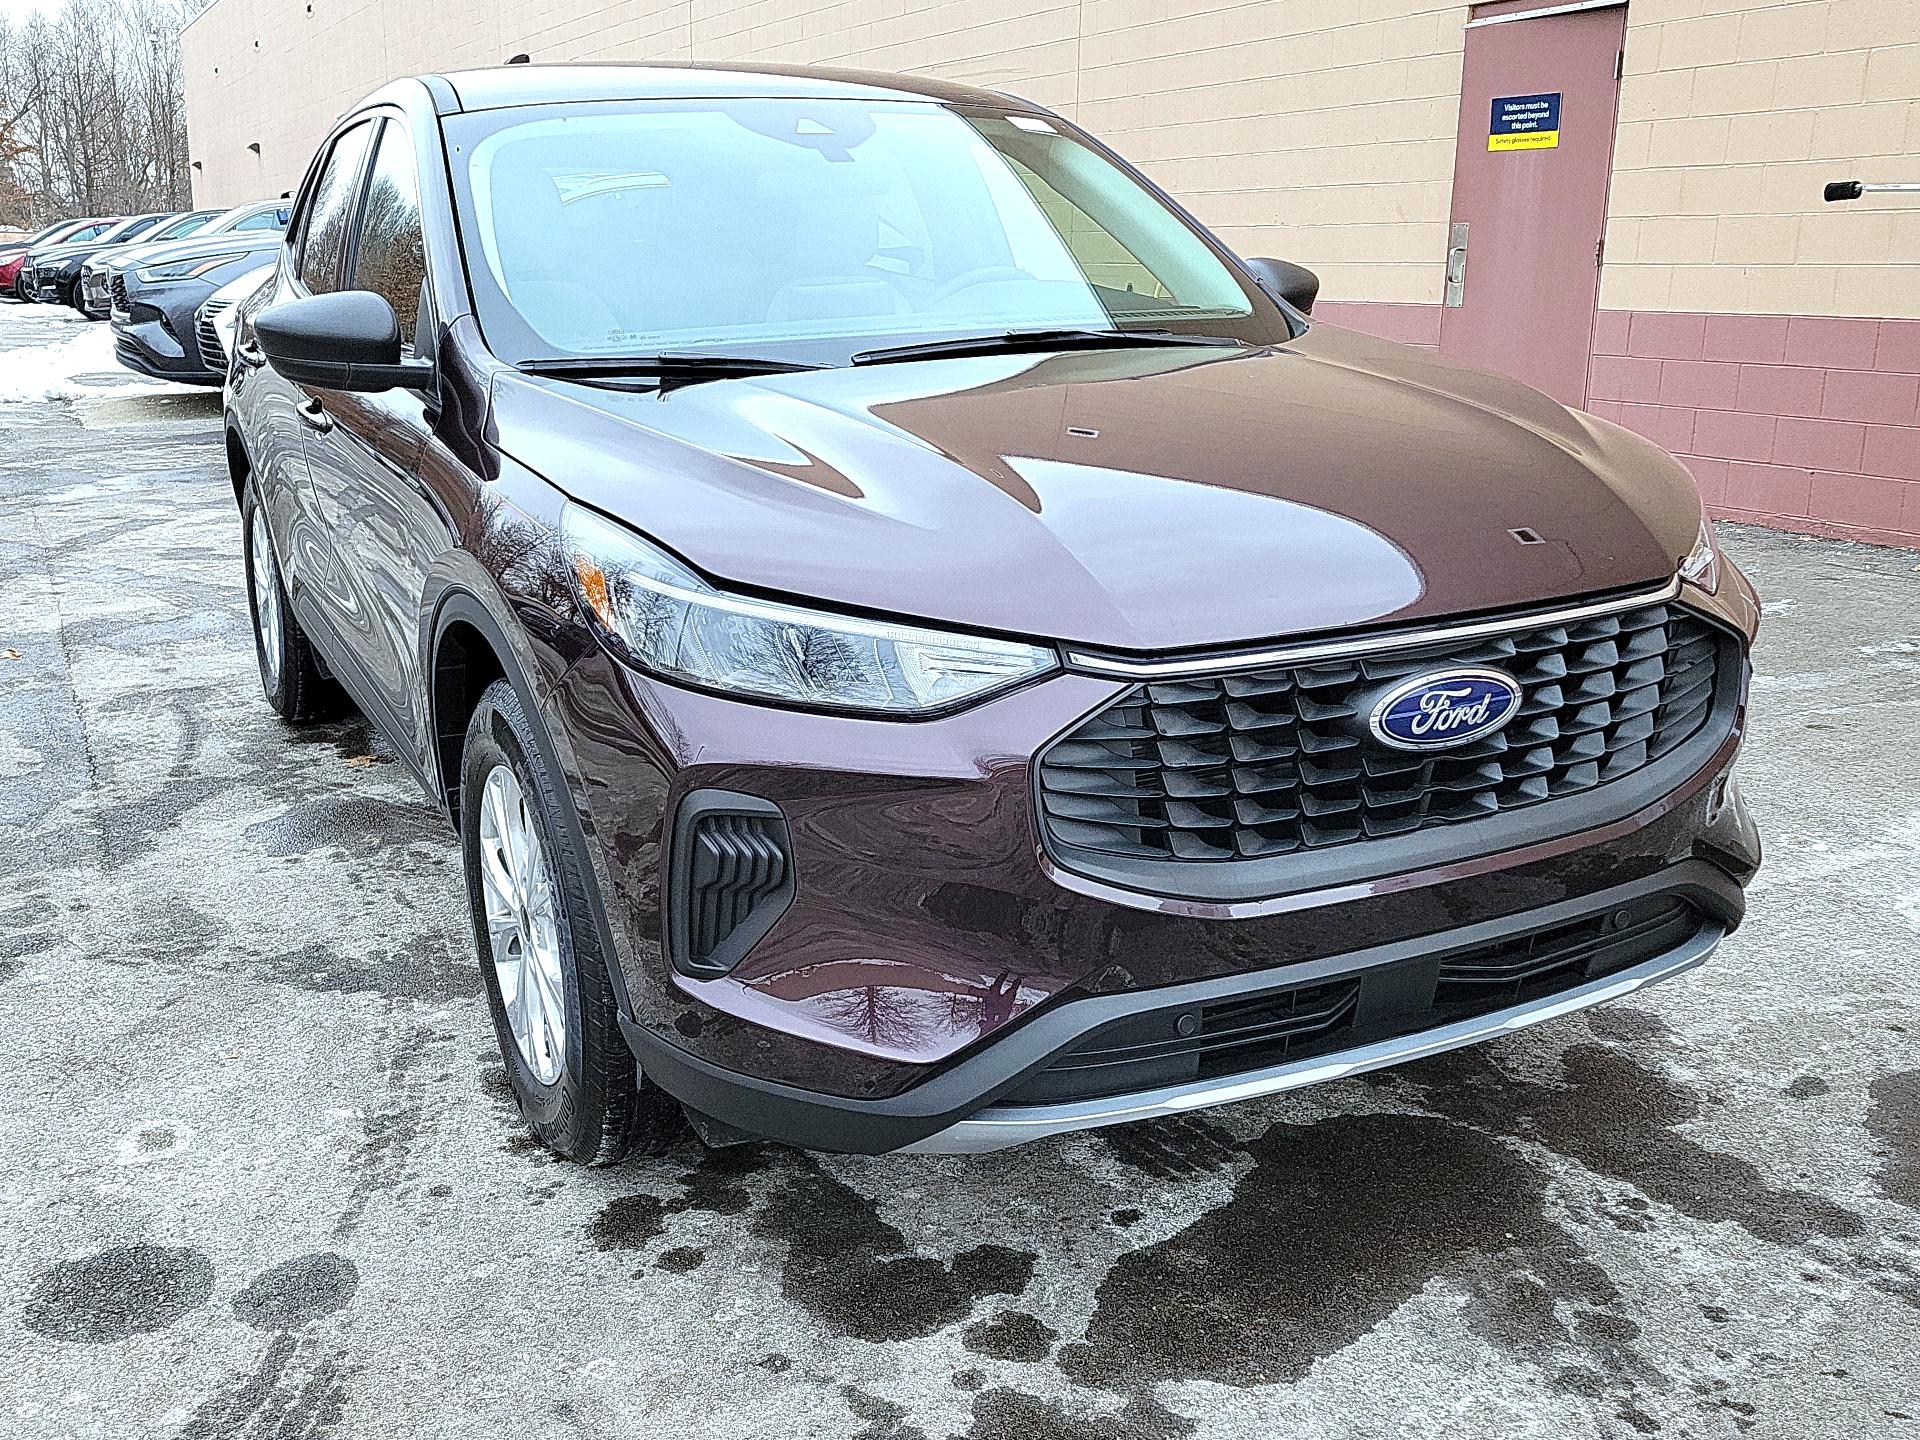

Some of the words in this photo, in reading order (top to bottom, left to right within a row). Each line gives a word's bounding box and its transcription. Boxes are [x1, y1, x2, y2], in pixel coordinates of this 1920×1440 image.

[1504, 103, 1525, 111] Visitors
[1501, 112, 1527, 121] escorted
[1528, 110, 1550, 120] beyond
[1511, 122, 1521, 130] this
[1522, 121, 1538, 130] point.
[1411, 687, 1491, 735] Ford
